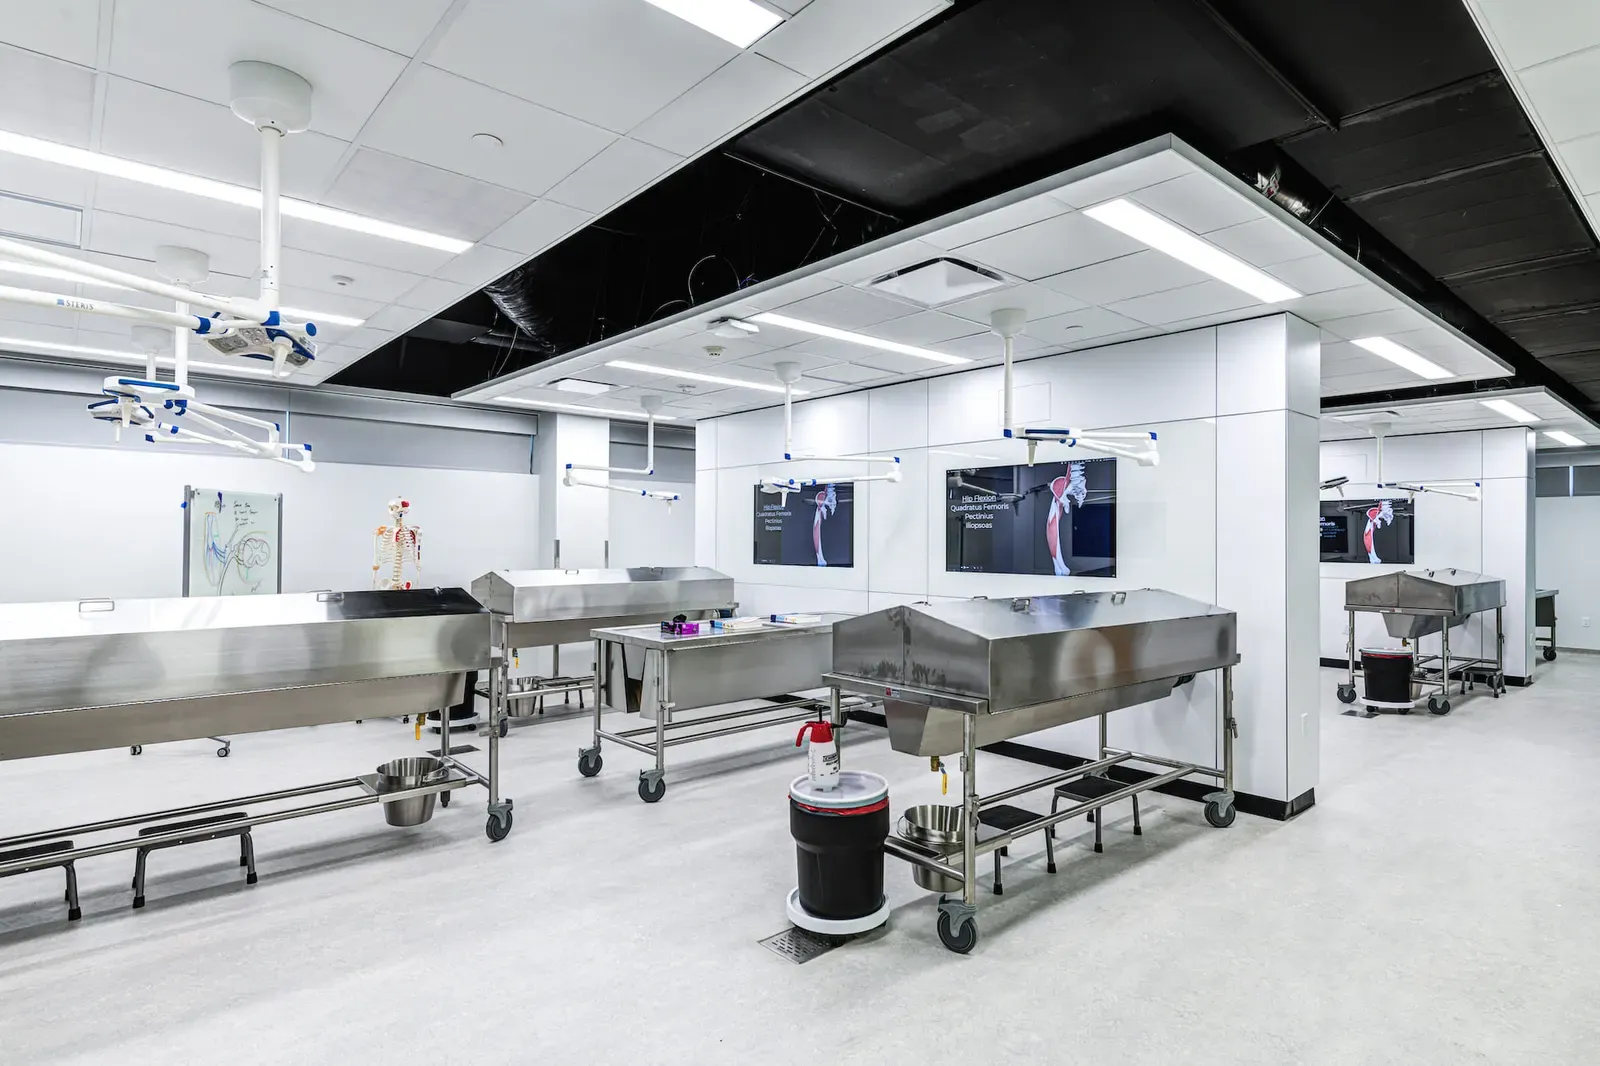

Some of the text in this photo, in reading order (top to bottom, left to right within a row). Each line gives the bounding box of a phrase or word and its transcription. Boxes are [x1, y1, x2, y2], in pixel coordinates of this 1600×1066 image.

[66, 300, 94, 310] STERIS
[951, 502, 1010, 512] Quadratus Femoris
[964, 512, 994, 520] Pectinius
[965, 522, 993, 530] Iliopsoas
